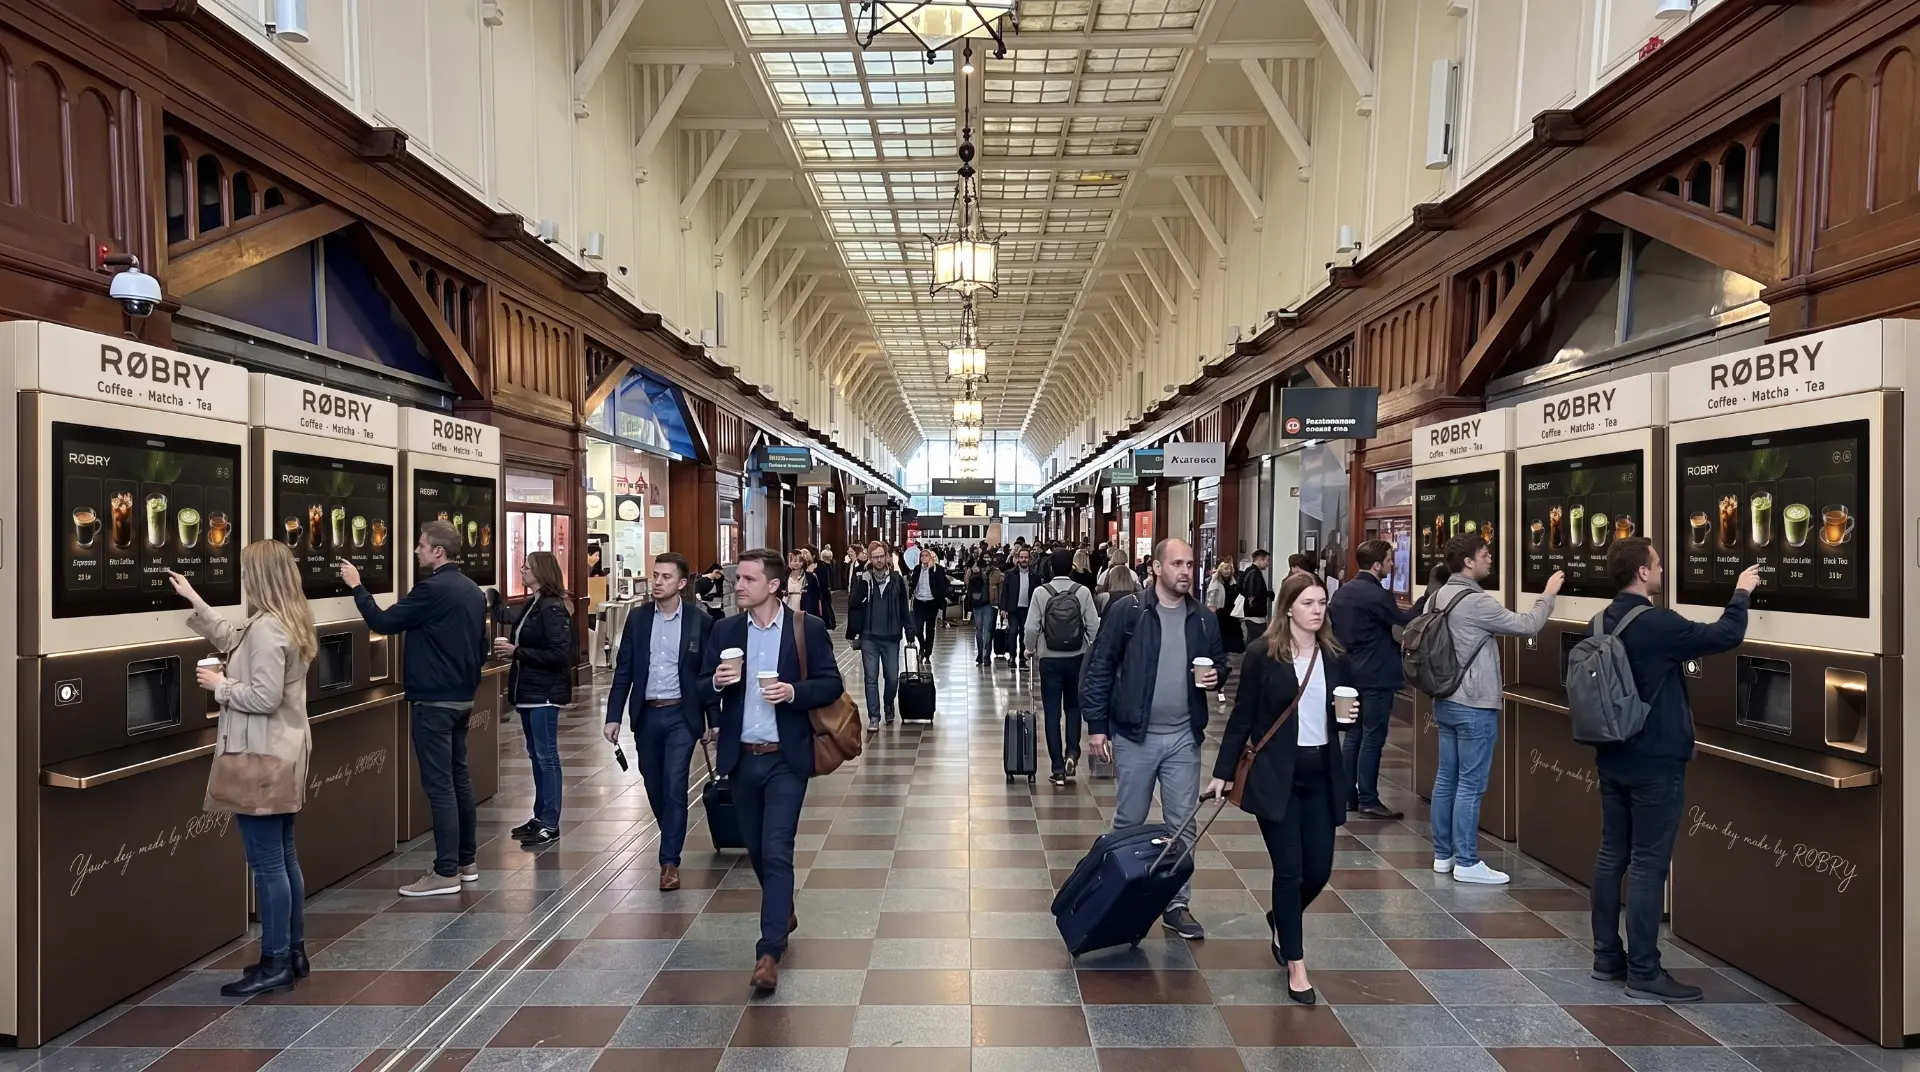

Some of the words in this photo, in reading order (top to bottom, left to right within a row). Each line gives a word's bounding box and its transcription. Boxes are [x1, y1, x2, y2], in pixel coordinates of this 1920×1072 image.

[101, 343, 211, 391] RØBRY
[1711, 341, 1824, 390] RØBRY
[97, 381, 133, 397] Coffee
[148, 390, 184, 407] Matcha
[197, 398, 212, 411] Tea
[303, 389, 372, 423] RØBRY
[1543, 387, 1617, 424] RØBRY
[1708, 396, 1738, 409] Coffee
[1752, 386, 1789, 402] Matcha
[1805, 381, 1825, 392] Tea
[300, 417, 323, 430] Coffee
[332, 423, 355, 436] Matcha
[363, 428, 374, 439] Tea
[433, 418, 482, 445] RØBRY
[1430, 418, 1481, 446] RØBRY
[1541, 428, 1562, 439] Coffee
[1570, 422, 1595, 434] Matcha
[1604, 417, 1617, 428] Tea
[69, 853, 110, 897] Your
[168, 825, 182, 856] by
[1688, 805, 1718, 837] Your
[1743, 834, 1771, 851] made
[1773, 839, 1788, 868] by
[1792, 843, 1858, 893] ROBRY
